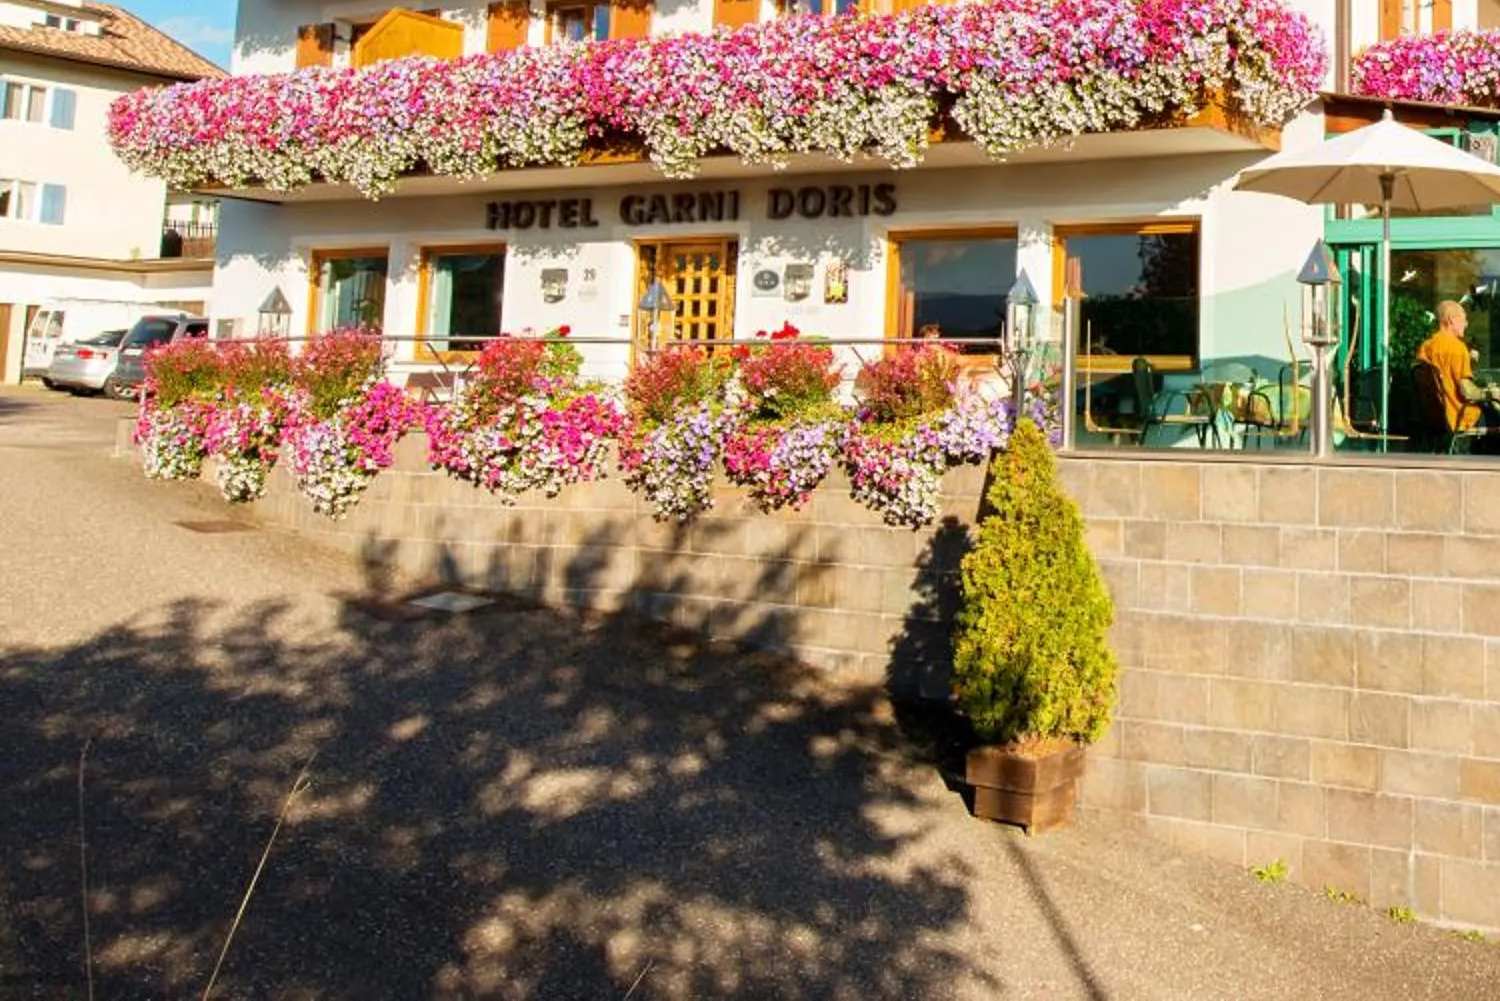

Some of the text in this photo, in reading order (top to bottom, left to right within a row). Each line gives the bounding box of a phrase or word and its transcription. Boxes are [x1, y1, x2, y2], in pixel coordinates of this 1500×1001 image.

[486, 182, 898, 230] HOTEL GARNI DORIS
